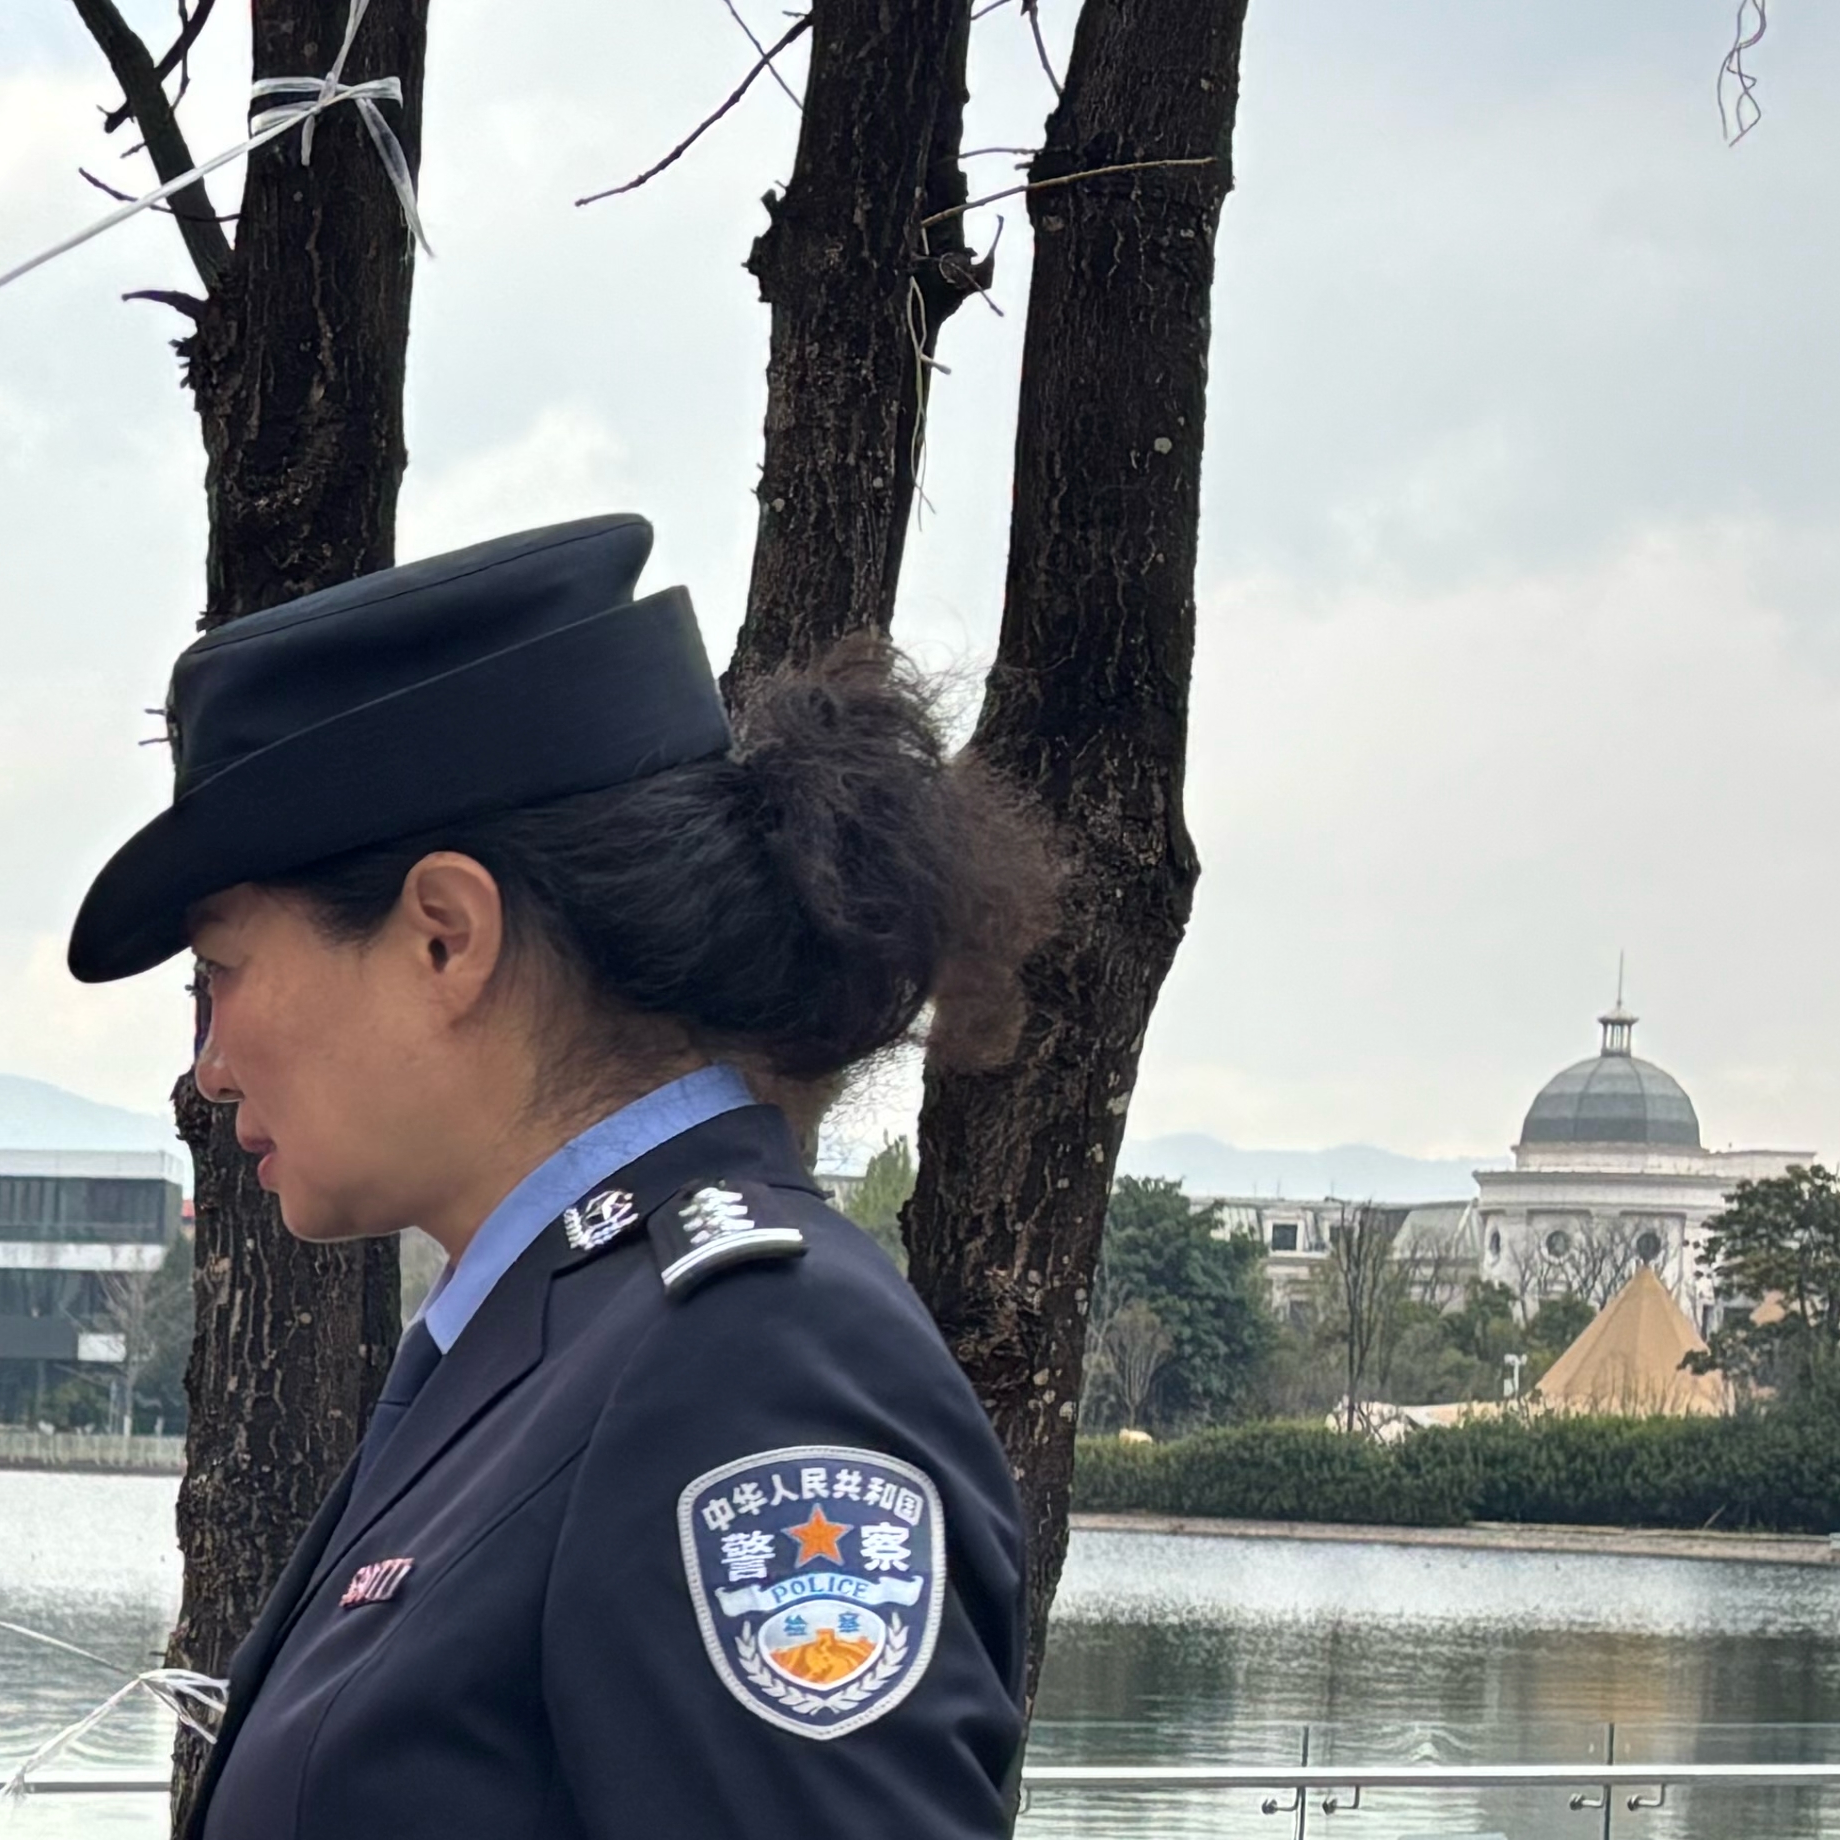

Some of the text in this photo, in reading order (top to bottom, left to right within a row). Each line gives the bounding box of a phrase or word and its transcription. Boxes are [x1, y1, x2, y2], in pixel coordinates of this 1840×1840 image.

[701, 1467, 924, 1531] 中华人民共和国
[721, 1521, 911, 1581] 警 察
[771, 1575, 869, 1604] POLICE
